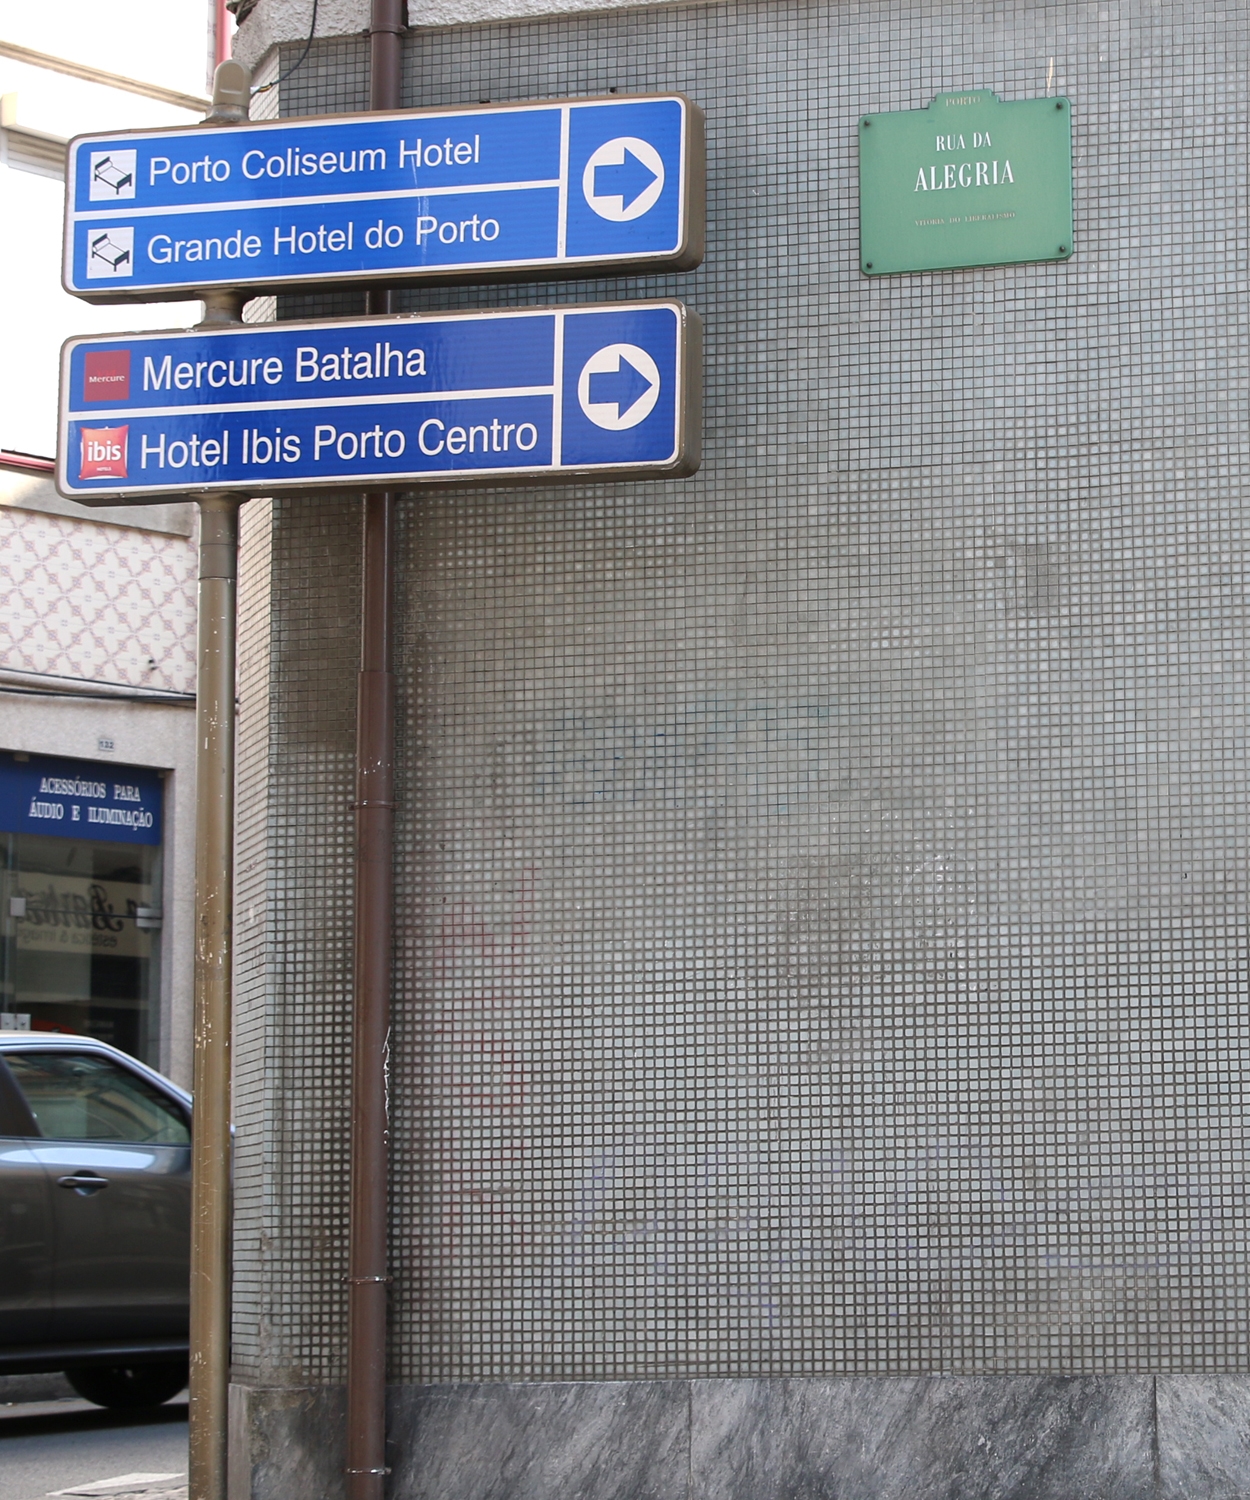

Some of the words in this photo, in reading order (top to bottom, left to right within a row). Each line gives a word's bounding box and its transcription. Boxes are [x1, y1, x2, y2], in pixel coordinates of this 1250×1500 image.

[946, 96, 981, 107] PORTO
[936, 134, 966, 152] RUA
[973, 132, 992, 148] DA
[148, 155, 231, 186] Porto
[241, 146, 386, 180] Coliseum
[399, 134, 481, 168] Hotel
[914, 160, 1014, 192] ALEGRIA
[147, 230, 261, 265] Grande
[274, 222, 353, 256] Hotel
[364, 218, 404, 248] do
[416, 214, 500, 246] Porto
[88, 375, 125, 383] Mercure
[142, 352, 283, 392] Mercure
[296, 342, 426, 383] Batalha
[87, 440, 122, 462] ibis
[140, 429, 229, 470] Hotel
[242, 428, 301, 464] Ibis
[313, 422, 406, 462] Porto
[418, 418, 538, 456] Centro
[39, 776, 107, 799] ACESSÓRIOS
[113, 784, 141, 802] PARA
[28, 796, 64, 820] ÁUDIO
[71, 805, 80, 821] E
[88, 807, 153, 831] ILUMINAÇÃO
